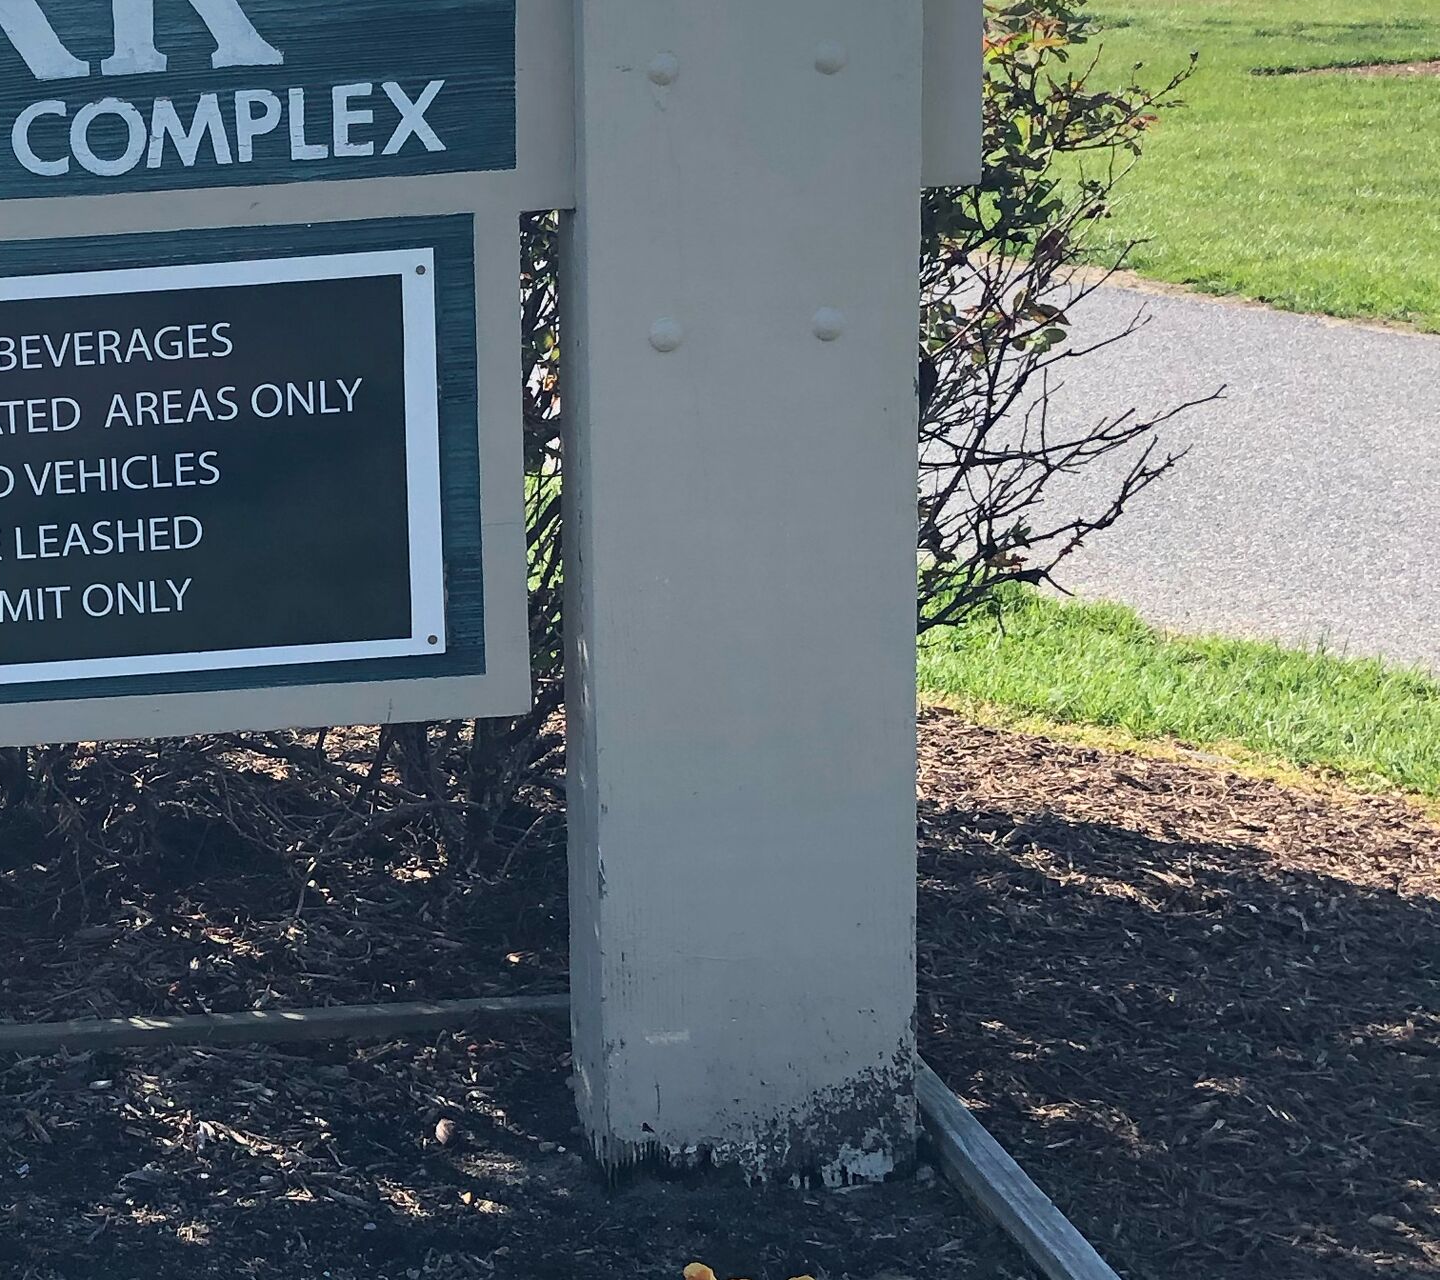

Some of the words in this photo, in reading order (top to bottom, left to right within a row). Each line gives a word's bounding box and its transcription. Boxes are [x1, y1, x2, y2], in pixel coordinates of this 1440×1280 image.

[11, 80, 446, 176] COMPLEX
[105, 387, 237, 427] AREAS
[252, 378, 362, 417] ONLY
[24, 452, 219, 495] VEHICLES
[16, 516, 202, 559] LEASHED
[83, 578, 191, 616] ONLY
